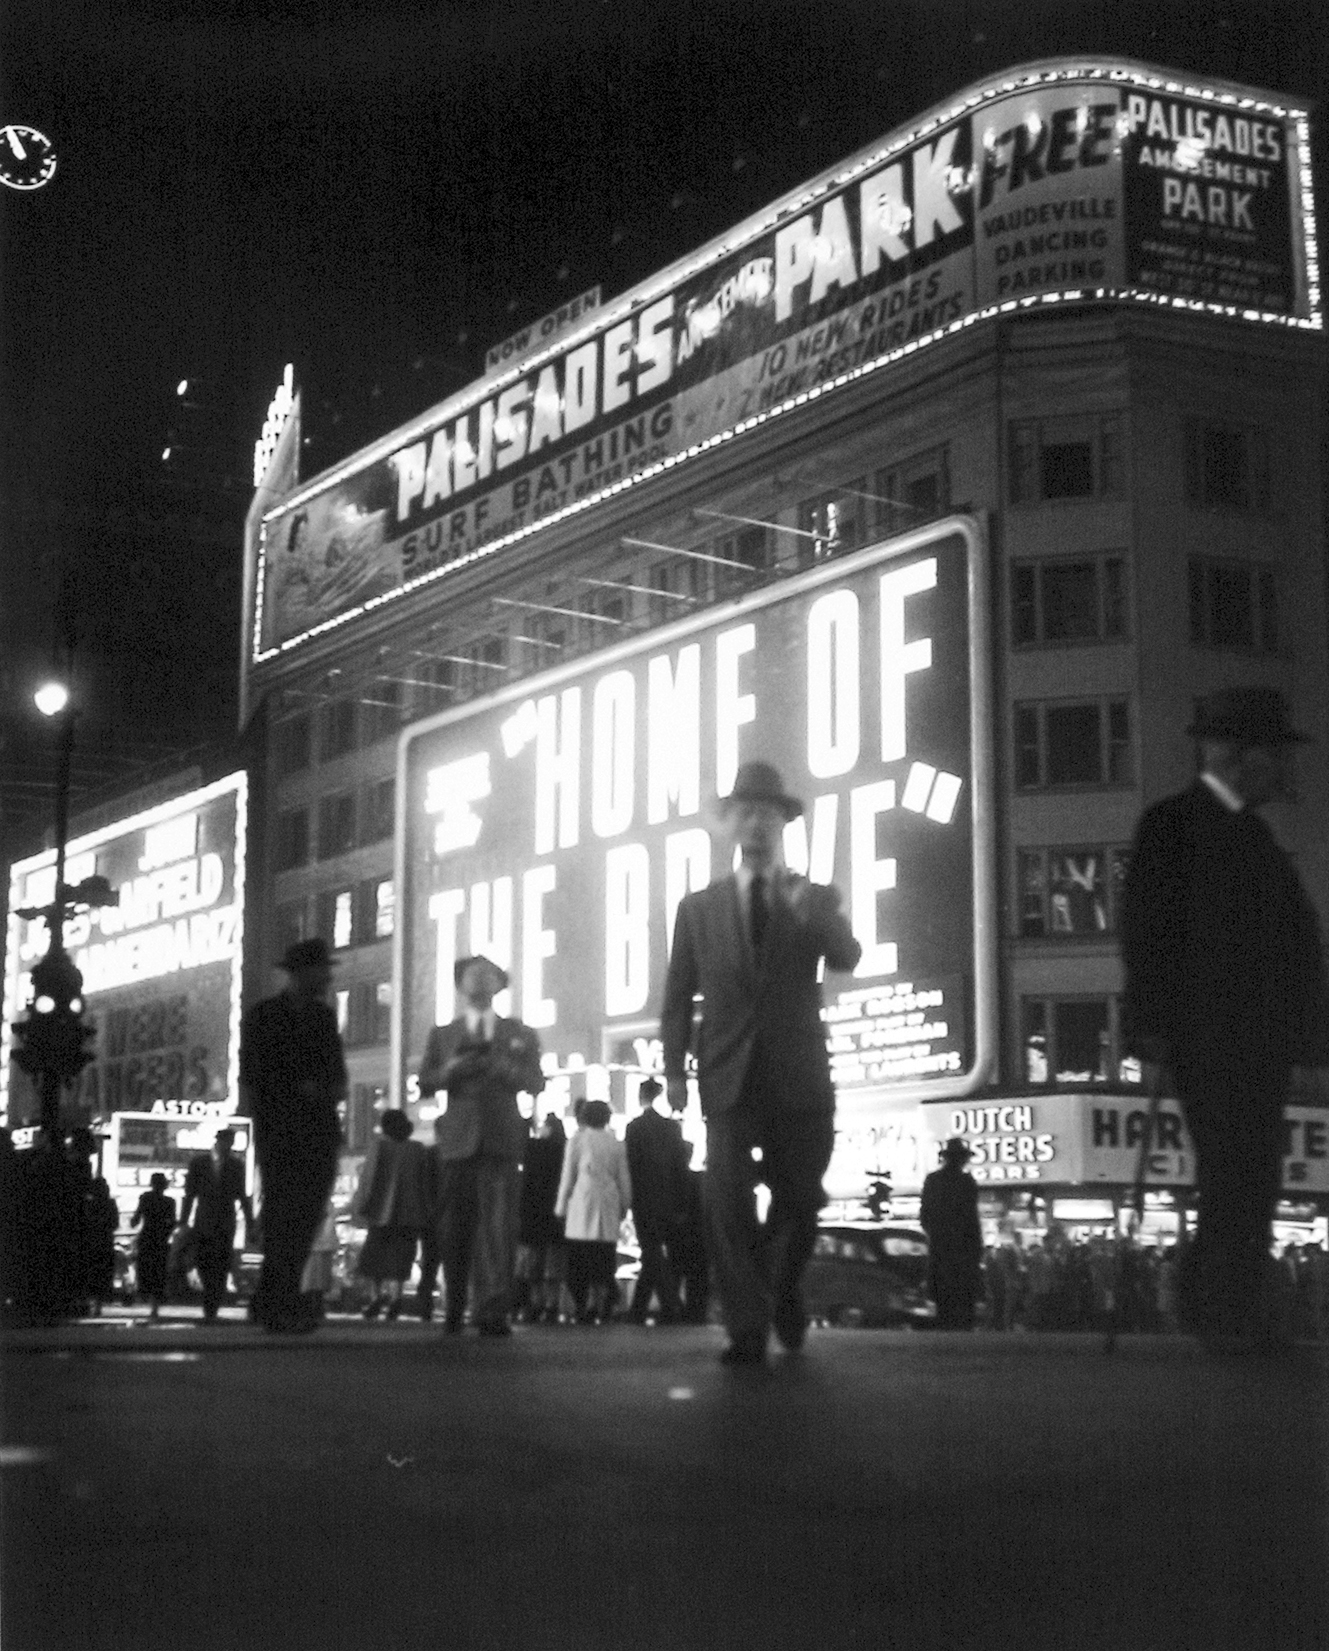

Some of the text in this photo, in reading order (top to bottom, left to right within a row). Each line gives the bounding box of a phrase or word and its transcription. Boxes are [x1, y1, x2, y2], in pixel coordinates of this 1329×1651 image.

[979, 102, 1119, 213] FREE
[1128, 95, 1281, 162] PALISADES
[775, 127, 964, 325] PARK
[983, 198, 1116, 238] VAUDEVILLE
[1163, 177, 1254, 230] PARK
[995, 228, 1109, 266] DANCING
[997, 258, 1107, 296] PARKING
[541, 293, 597, 335] OPEN
[758, 270, 943, 383] 10 NEW RIDES
[814, 290, 965, 383] RESTAURANTS
[392, 294, 675, 522] PALISADES
[402, 402, 674, 565] SURF BATHING
[807, 557, 938, 780] OF
[427, 865, 557, 1028] THE
[936, 1133, 1056, 1170] STERS
[951, 1105, 1034, 1135] DUTCH
